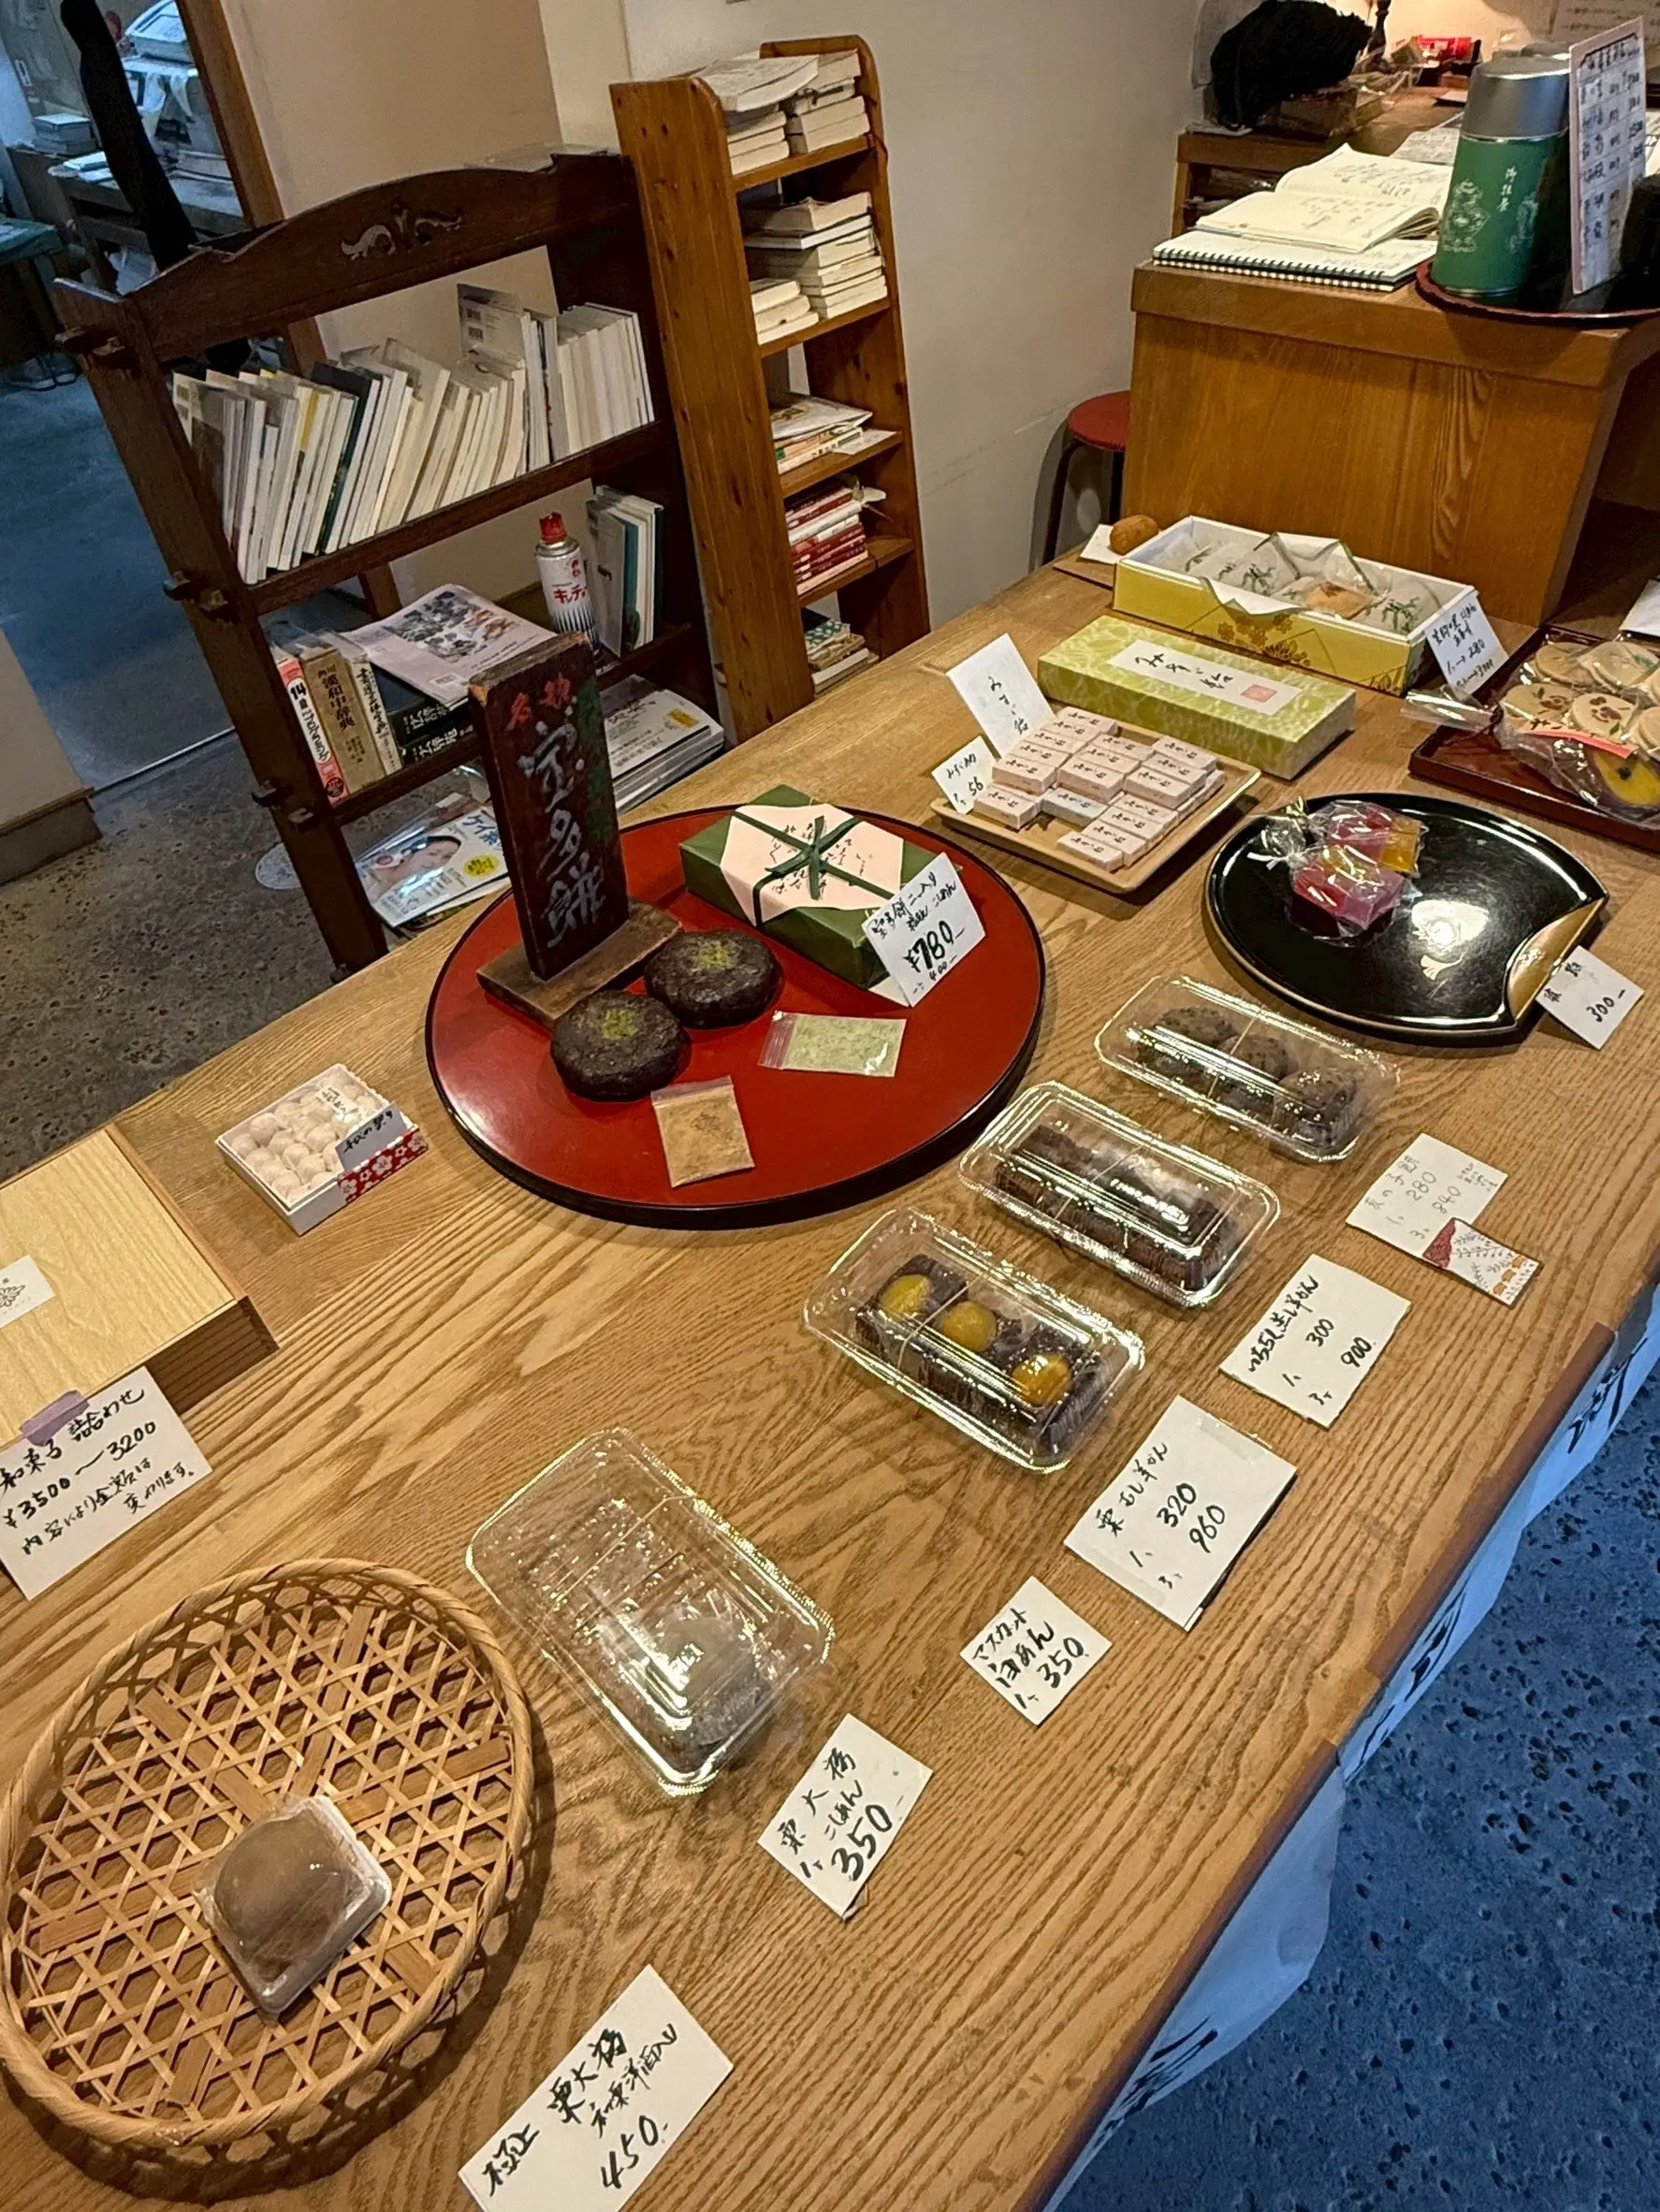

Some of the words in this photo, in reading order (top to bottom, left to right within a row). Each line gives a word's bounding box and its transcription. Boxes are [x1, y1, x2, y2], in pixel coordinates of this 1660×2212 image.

[1405, 1171, 1436, 1201] 280
[1432, 1186, 1461, 1215] 840
[1305, 1318, 1334, 1347] 300
[1340, 1336, 1373, 1369] 900
[1156, 1482, 1198, 1528] 320
[1189, 1505, 1226, 1554] 960
[1036, 1637, 1085, 1689] 350
